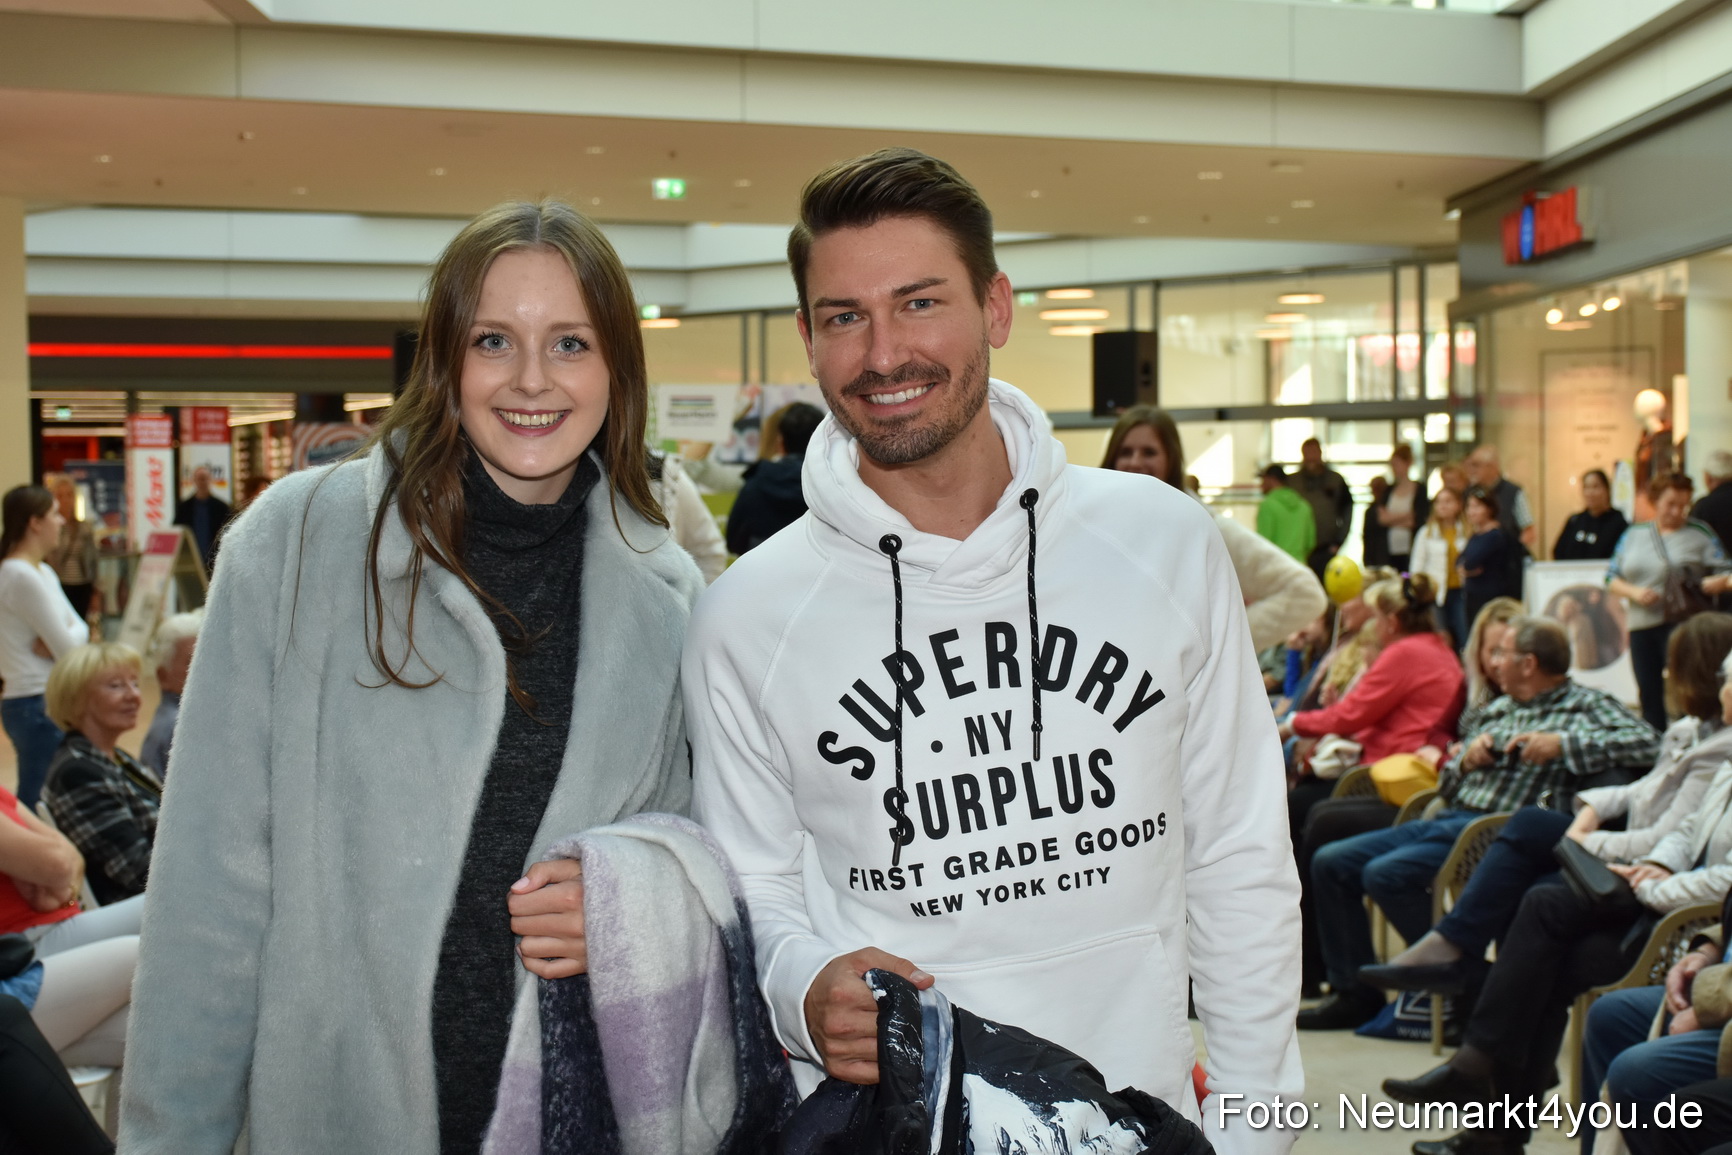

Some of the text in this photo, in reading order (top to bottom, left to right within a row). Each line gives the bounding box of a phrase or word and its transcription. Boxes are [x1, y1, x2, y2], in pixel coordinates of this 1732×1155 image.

[817, 621, 1166, 781] SUPERDRY
[964, 709, 1013, 758] NY
[883, 748, 1116, 846] SURPLUS
[849, 812, 1167, 892] FIRST GRADE GOODS
[910, 866, 1111, 917] NEW YORK CITY
